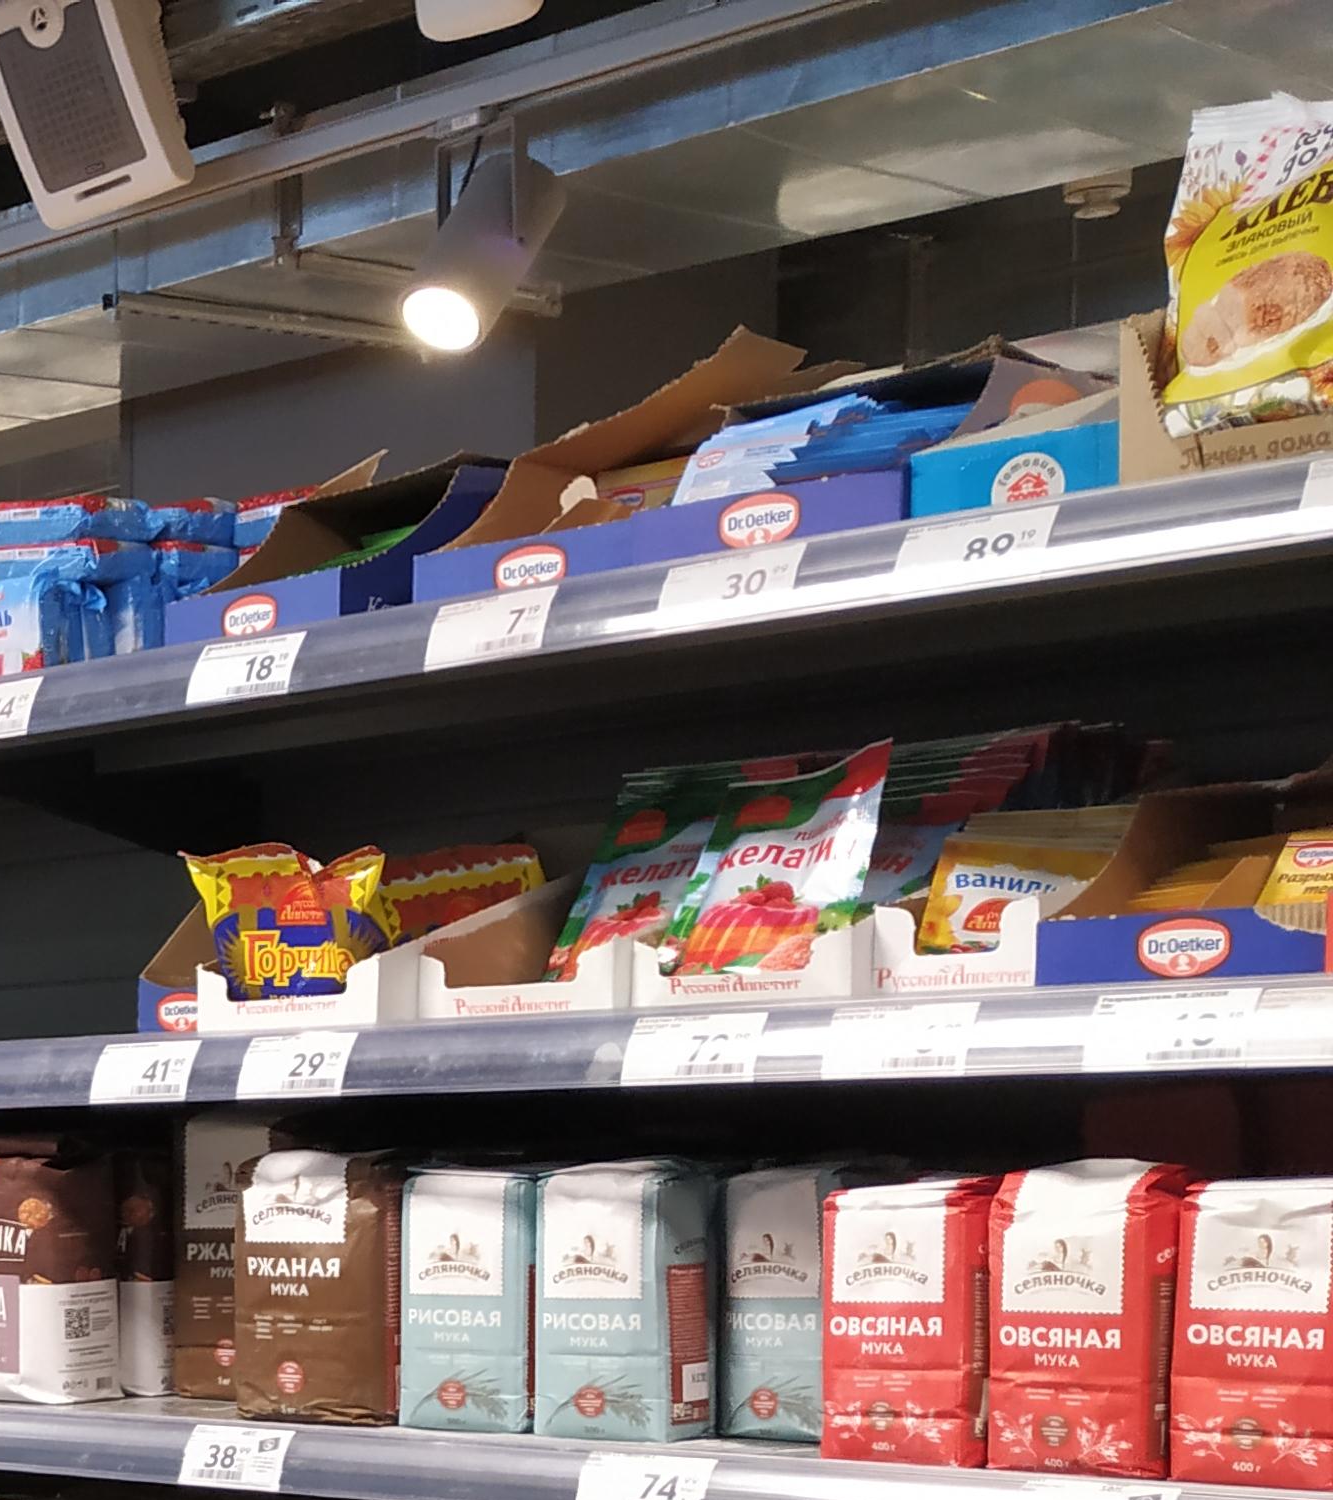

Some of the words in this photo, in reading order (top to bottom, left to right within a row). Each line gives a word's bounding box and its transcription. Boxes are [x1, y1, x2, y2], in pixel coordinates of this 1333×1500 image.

[727, 508, 793, 532] Dr.Oetker
[502, 560, 560, 582] Dr.Oetker
[229, 608, 273, 629] Dr.Oetker
[244, 655, 274, 683] 18
[1147, 934, 1224, 956] Dr.Oetker
[250, 1203, 334, 1227] селяночка
[246, 1257, 342, 1278] РЖАНАЯ
[417, 1265, 493, 1285] селяночка
[551, 1264, 630, 1286] селяночка
[844, 1264, 929, 1288] селяночка
[269, 1282, 310, 1298] МУКА
[1013, 1272, 1107, 1298] селяночка
[1206, 1270, 1314, 1295] селяночка
[407, 1308, 503, 1328] РИСОВАЯ
[542, 1312, 643, 1332] РИСОВАЯ
[829, 1315, 943, 1337] ОВСЯНАЯ
[433, 1330, 471, 1344] МУКА
[568, 1334, 609, 1348] МУКА
[744, 1335, 784, 1349] МУКА
[998, 1324, 1122, 1351] ОВСЯНАЯ
[1186, 1322, 1325, 1351] ОВСЯНАЯ
[860, 1340, 905, 1356] МУКА
[1033, 1352, 1081, 1369] МУКА
[1225, 1352, 1279, 1369] МУКА
[203, 1444, 237, 1469] 38
